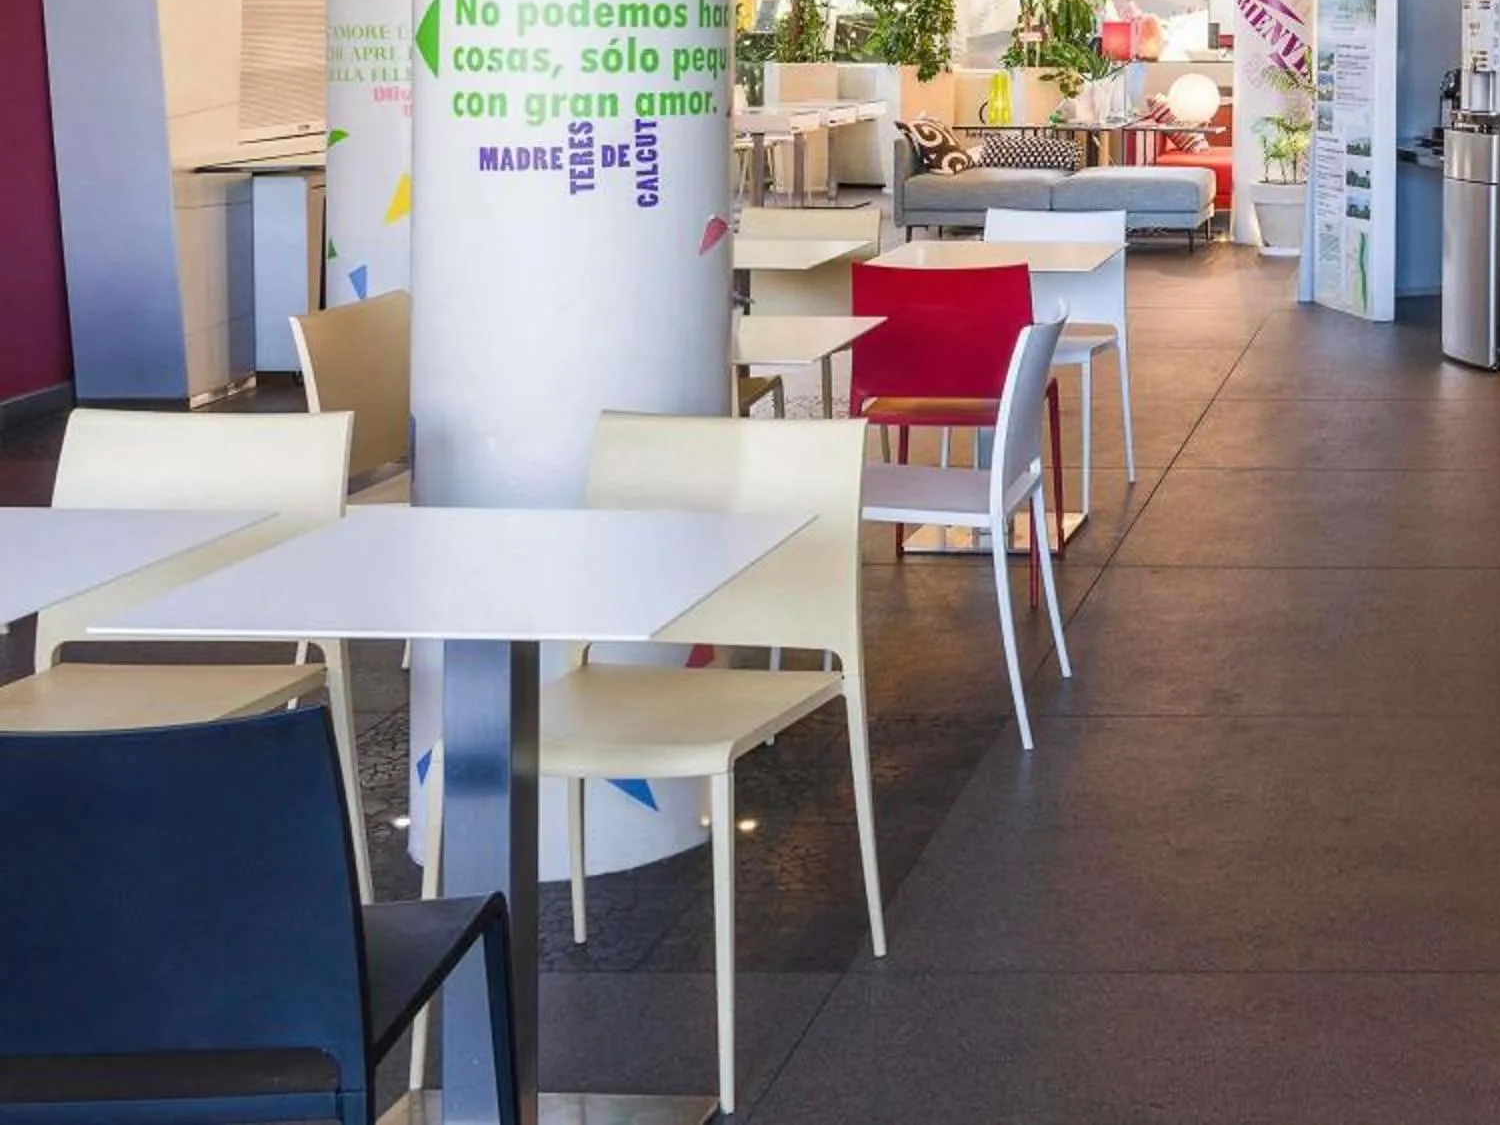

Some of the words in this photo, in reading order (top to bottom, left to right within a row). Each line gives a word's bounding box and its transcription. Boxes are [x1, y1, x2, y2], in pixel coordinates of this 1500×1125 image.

[452, 45, 564, 79] cosas,
[580, 36, 659, 73] sólo
[452, 90, 508, 118] con
[525, 92, 619, 127] gran
[635, 90, 718, 118] amor.
[479, 146, 564, 172] MADRE
[602, 144, 631, 168] DE
